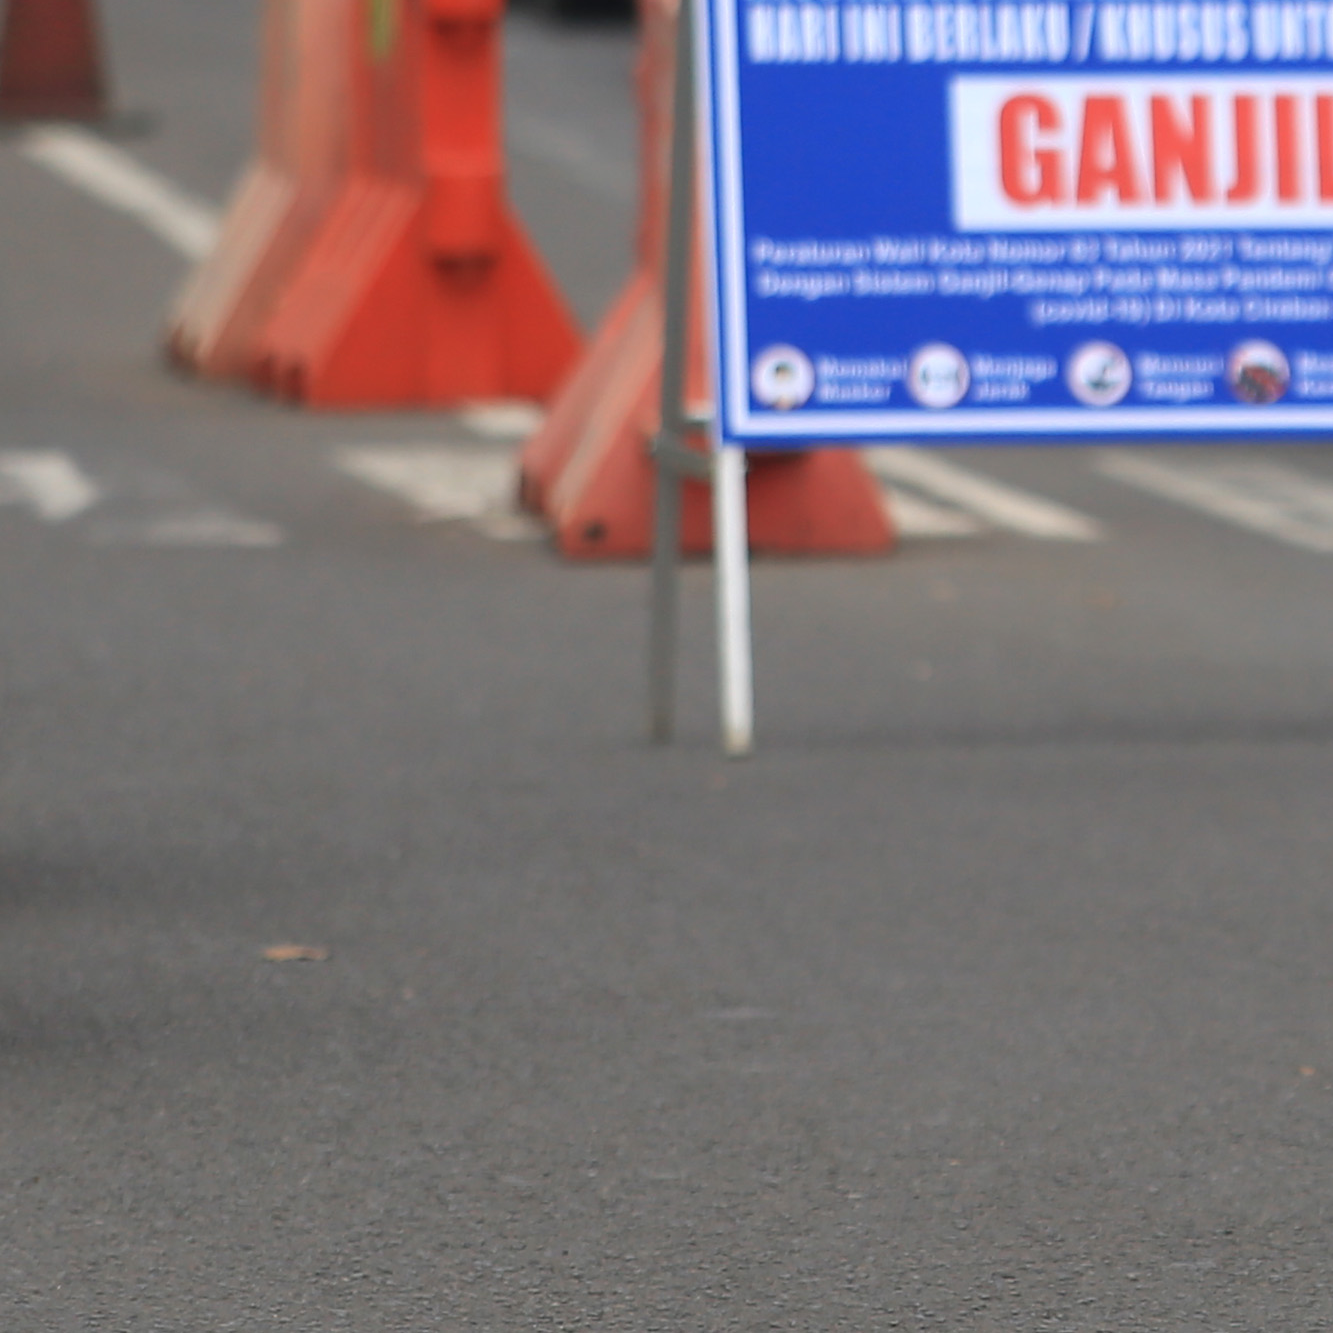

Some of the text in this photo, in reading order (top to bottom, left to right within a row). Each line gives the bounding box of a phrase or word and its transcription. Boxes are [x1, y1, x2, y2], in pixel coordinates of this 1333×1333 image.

[749, 3, 841, 63] HARI
[843, 3, 902, 63] INI
[905, 3, 1070, 63] BERLAKU
[1101, 2, 1249, 62] KHUSUS
